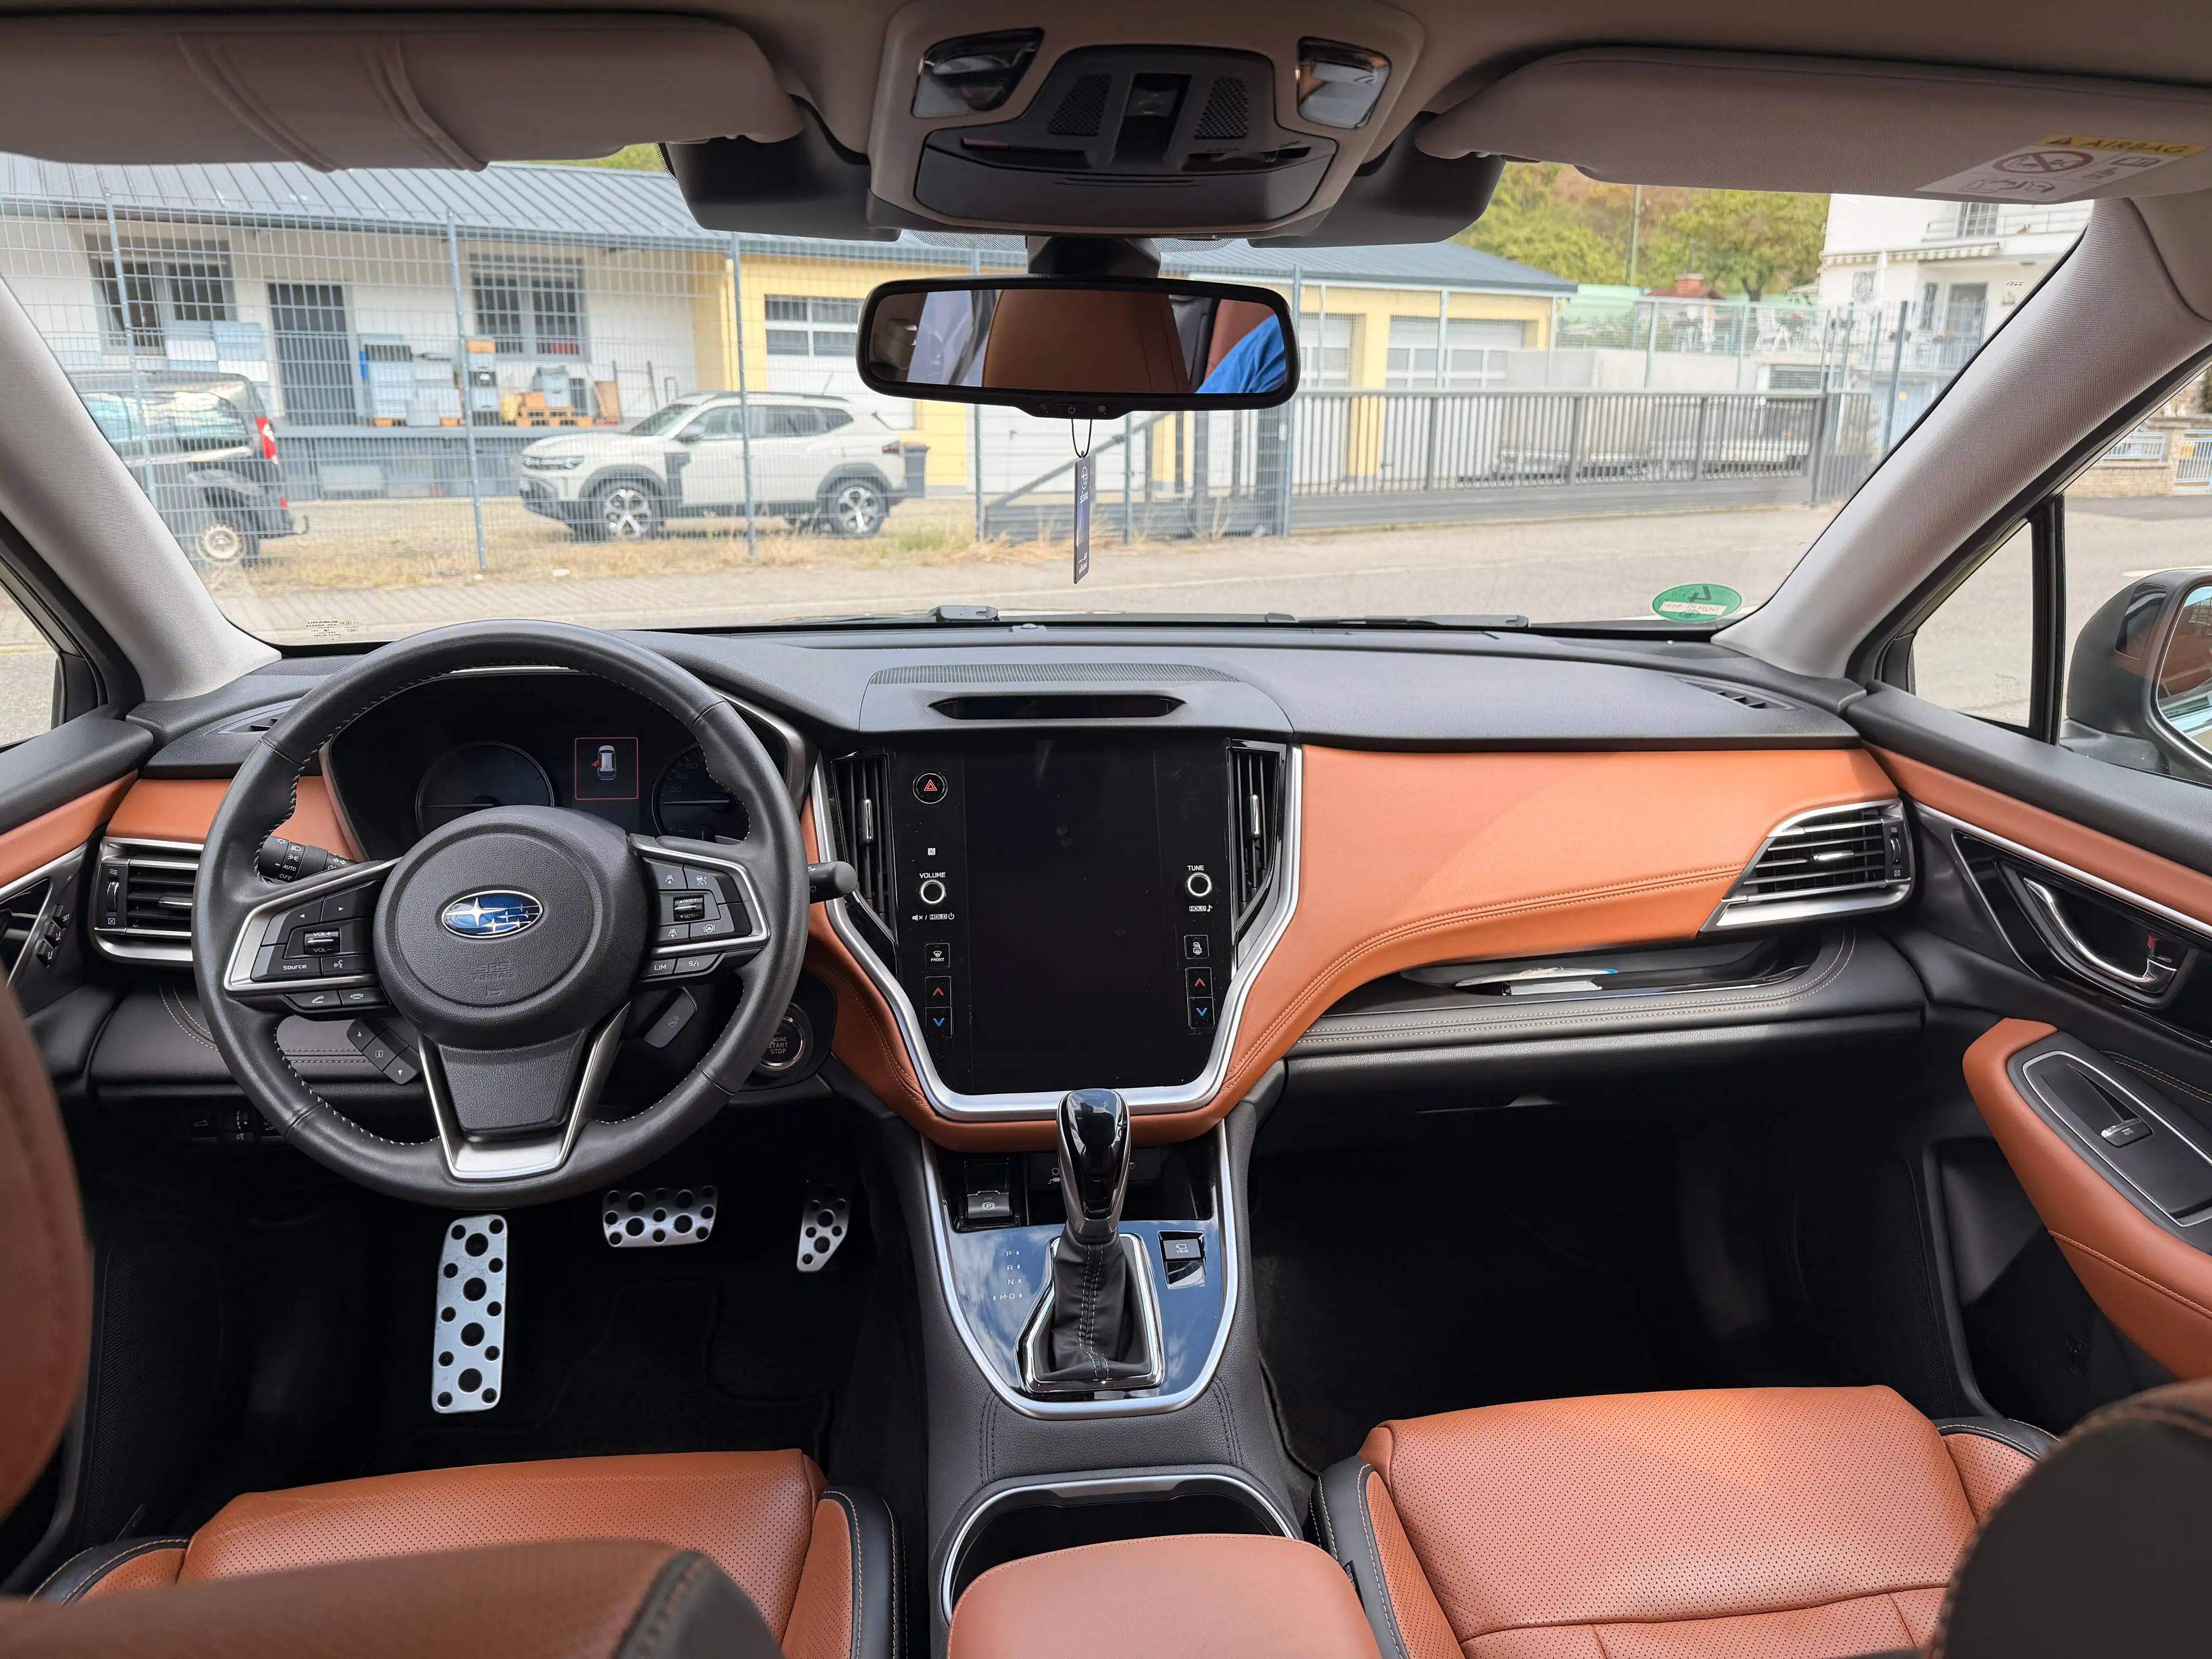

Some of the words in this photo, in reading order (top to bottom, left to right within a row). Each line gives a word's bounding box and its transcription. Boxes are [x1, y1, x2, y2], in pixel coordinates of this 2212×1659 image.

[2080, 139, 2190, 153] AIRBAG
[477, 963, 509, 971] SRS
[472, 972, 515, 981] AIRBAG
